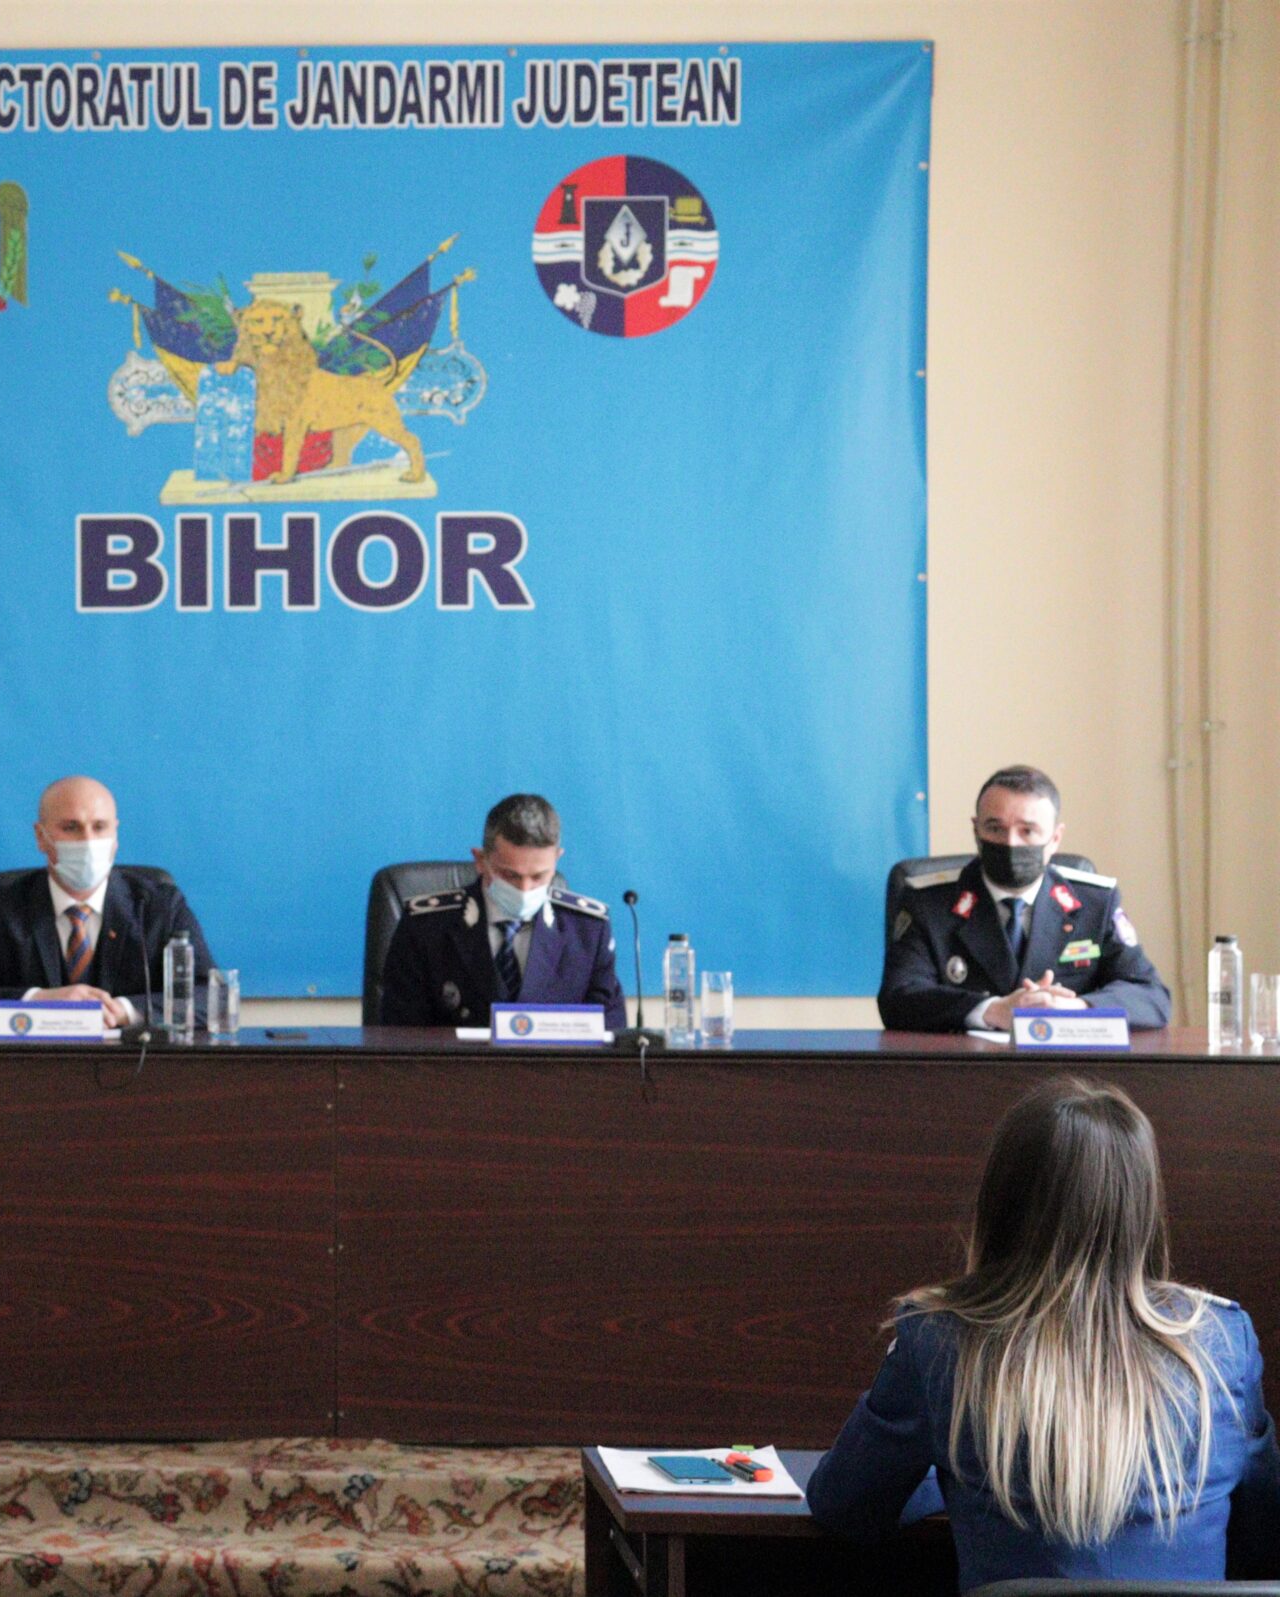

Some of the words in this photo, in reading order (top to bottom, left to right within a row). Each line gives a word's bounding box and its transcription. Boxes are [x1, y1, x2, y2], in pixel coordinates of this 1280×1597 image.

[219, 64, 277, 130] DE
[288, 61, 504, 130] JANDARMI
[516, 58, 741, 129] JUDETEAN
[75, 511, 535, 613] BIHOR
